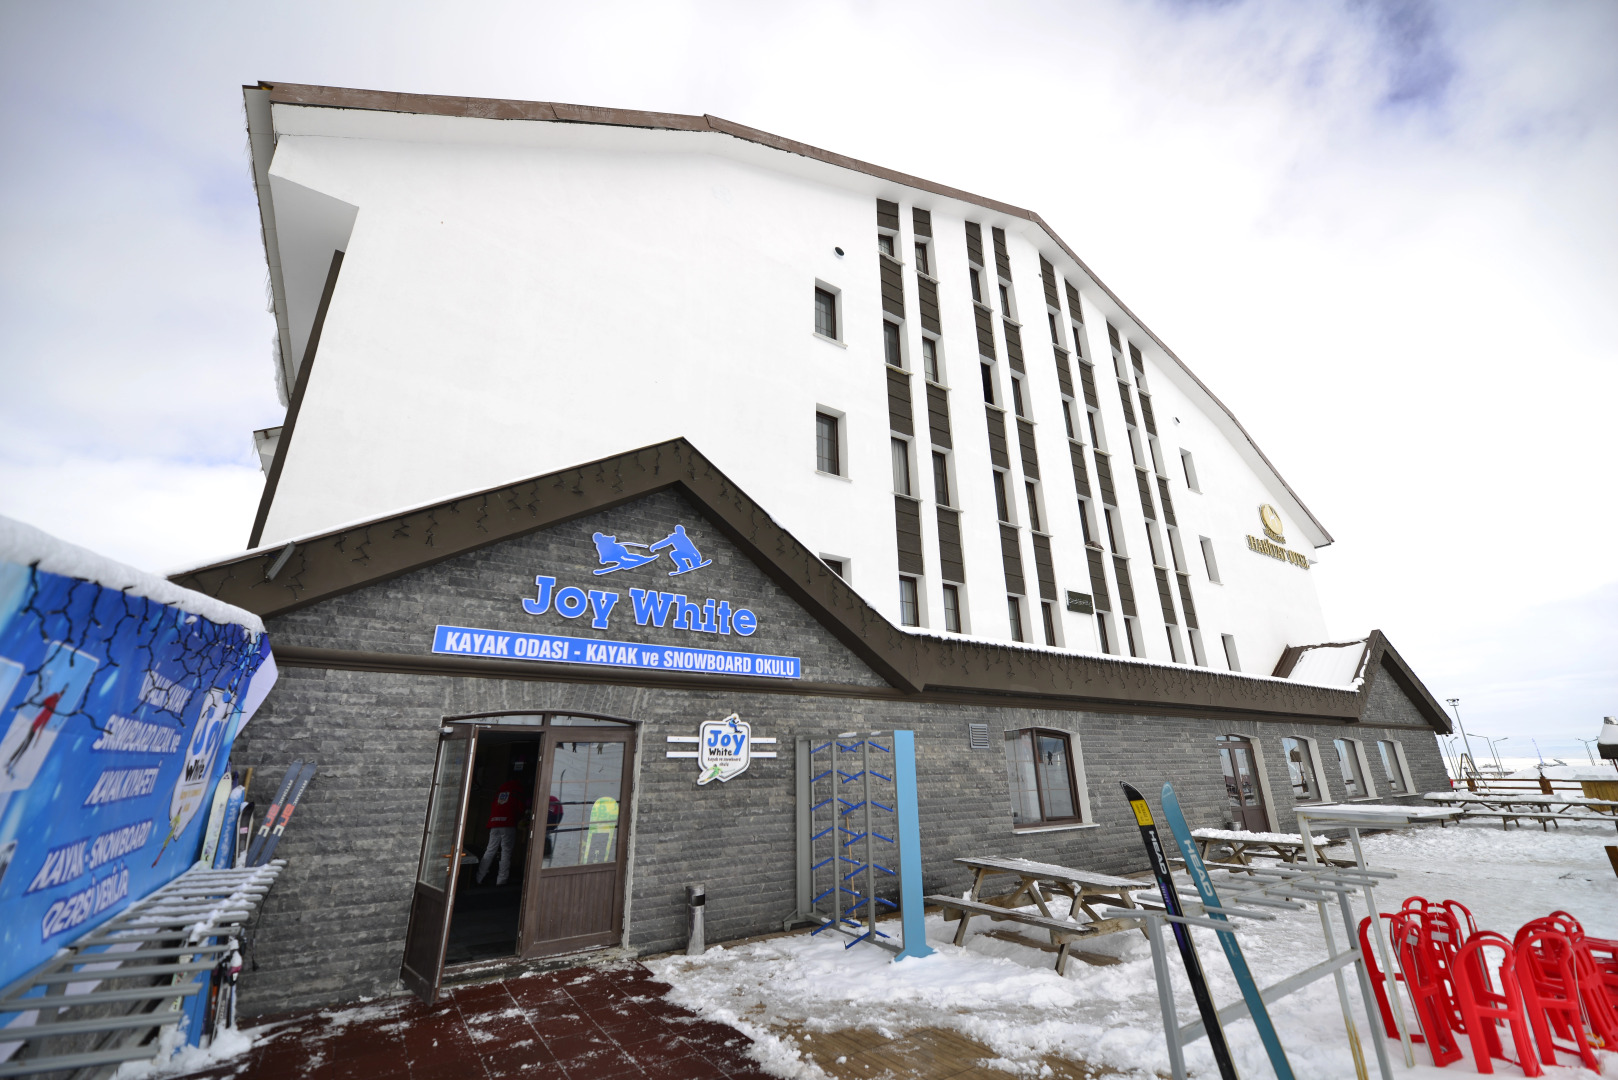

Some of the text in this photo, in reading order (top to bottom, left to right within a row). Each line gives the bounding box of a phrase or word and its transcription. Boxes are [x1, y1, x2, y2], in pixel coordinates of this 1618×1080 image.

[522, 575, 757, 636] Joy White
[445, 631, 510, 655] KAYAK
[514, 637, 569, 660] ODASI
[586, 643, 638, 665] KAYAK
[642, 651, 659, 666] ve
[663, 650, 751, 673] SNOWBOARD
[755, 658, 794, 676] OKULU
[707, 730, 746, 756] Joy
[709, 748, 733, 756] White
[27, 840, 87, 893] KAYAK
[90, 820, 152, 869] SNOWBOARD
[1148, 830, 1168, 875] HEAD
[1183, 839, 1214, 897] HEAD
[42, 876, 96, 940] DERSİ
